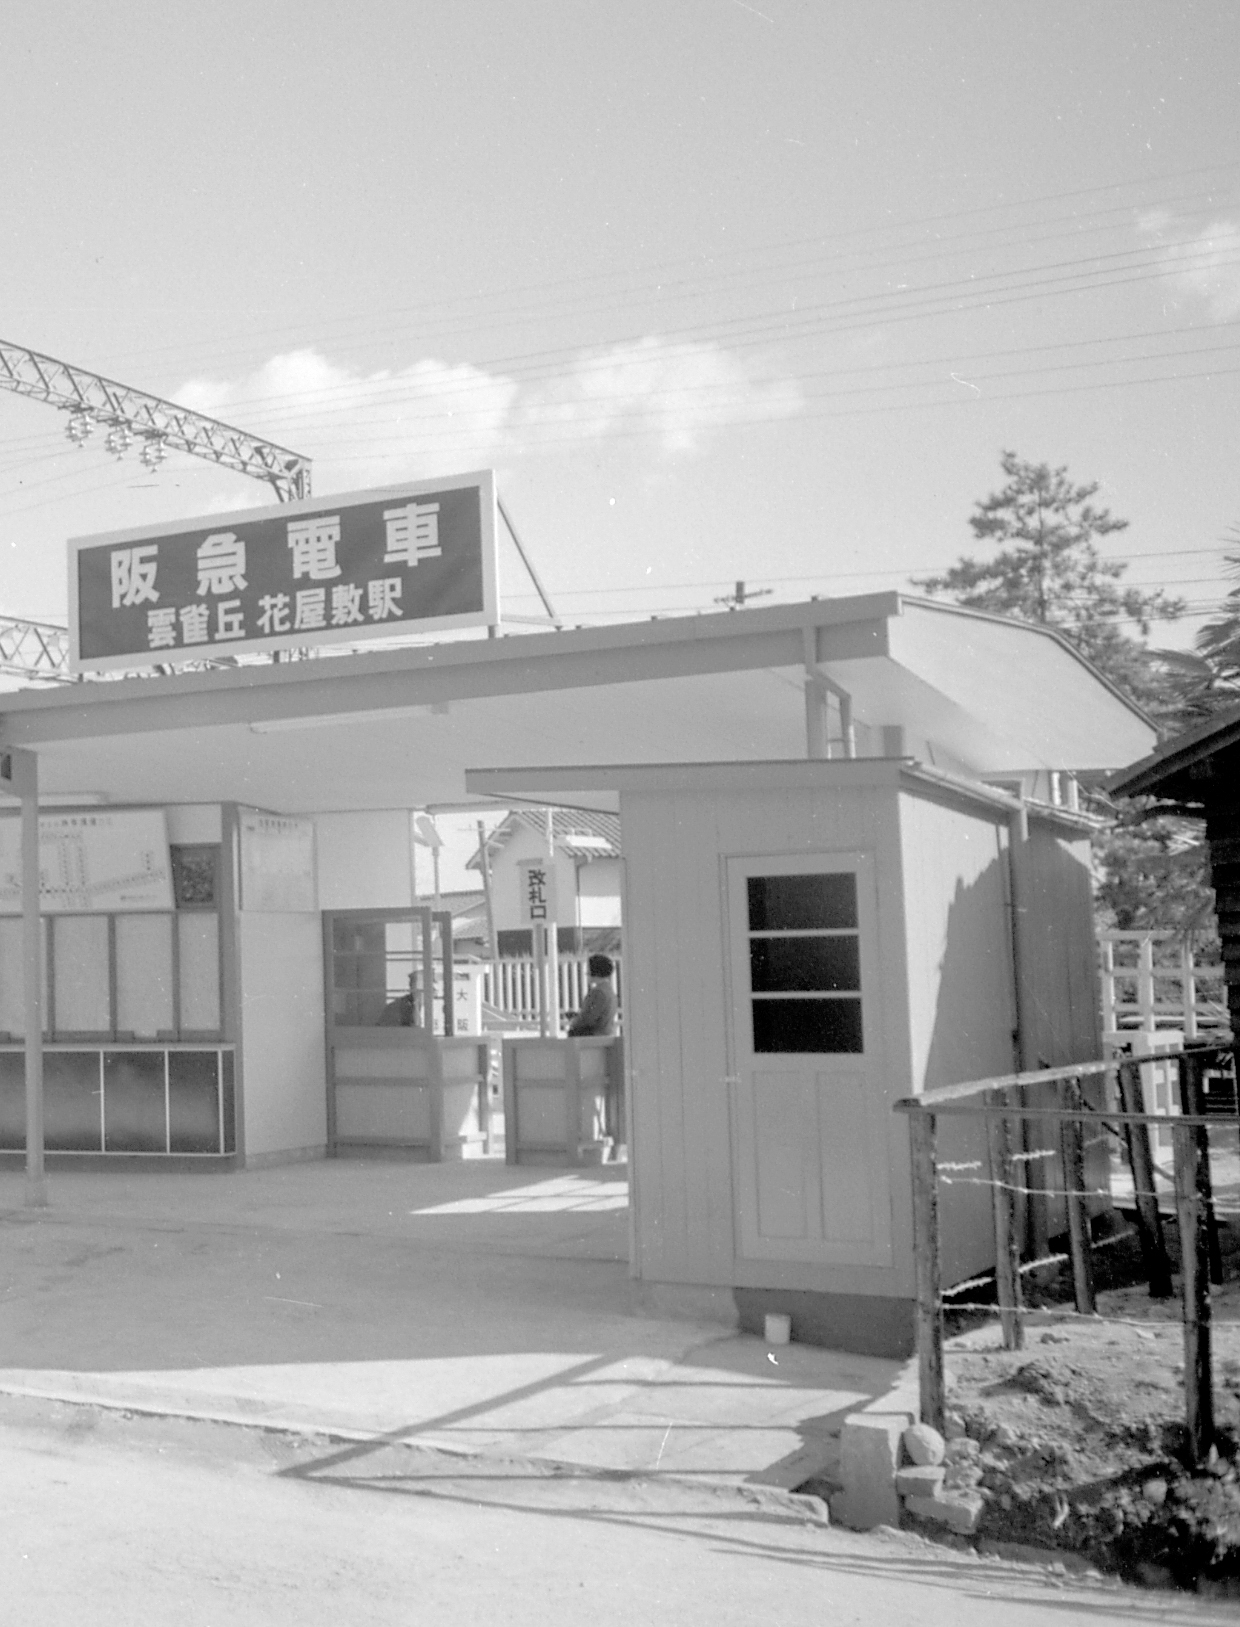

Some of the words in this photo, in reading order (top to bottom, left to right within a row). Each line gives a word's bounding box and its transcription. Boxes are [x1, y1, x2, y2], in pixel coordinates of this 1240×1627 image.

[110, 503, 443, 608] 阪急電車
[527, 868, 547, 920] 改札口
[456, 987, 470, 1032] 大阪
